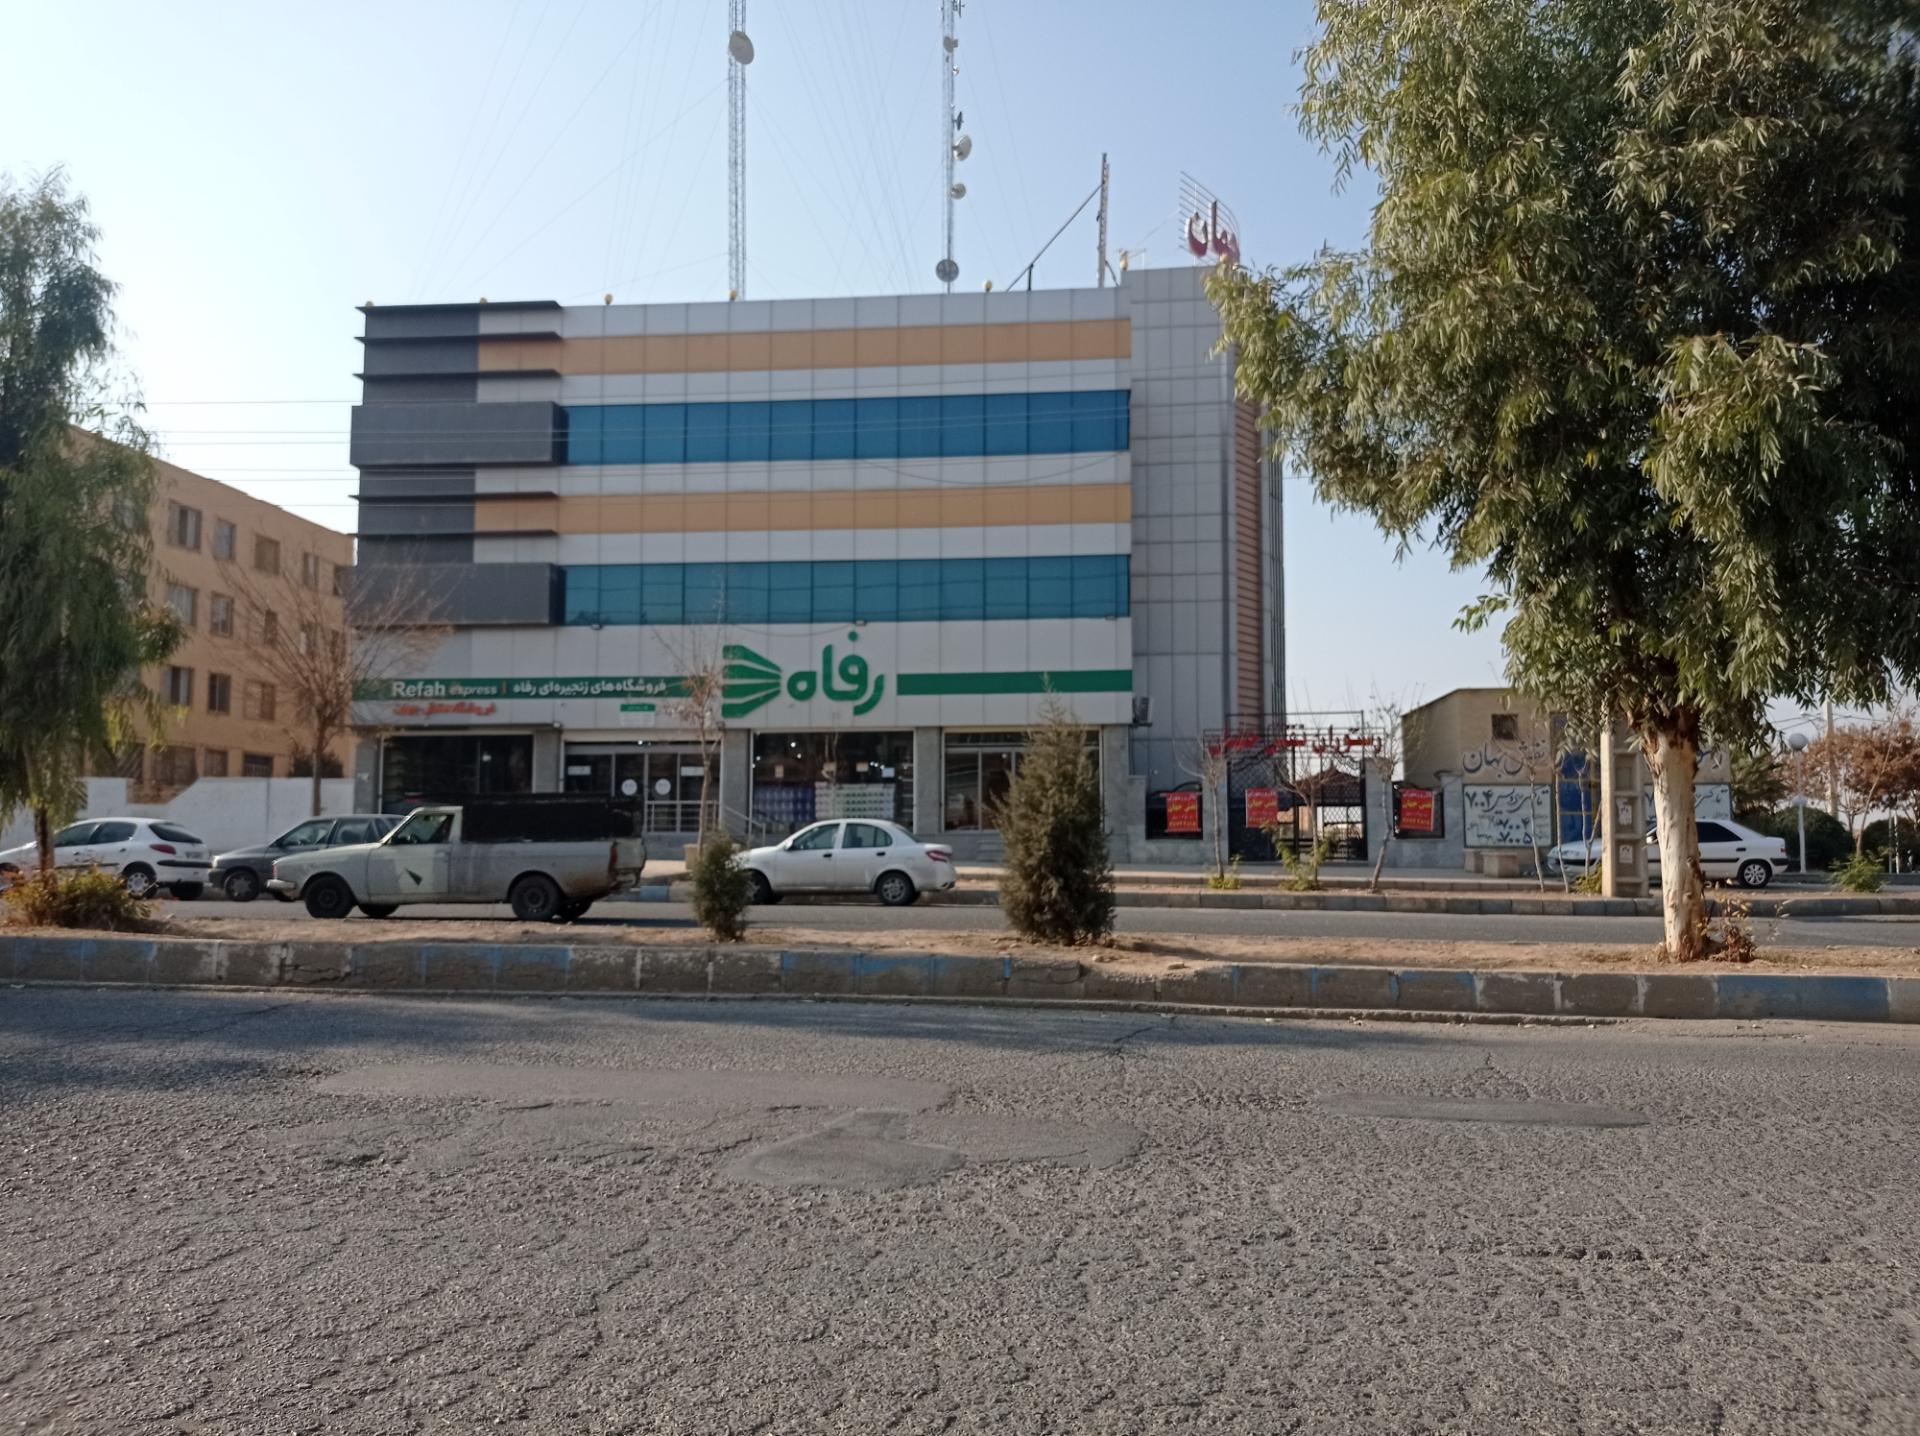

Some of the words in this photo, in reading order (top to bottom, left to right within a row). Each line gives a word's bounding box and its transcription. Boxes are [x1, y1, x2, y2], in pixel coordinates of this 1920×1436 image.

[787, 631, 885, 716] رفاه
[393, 681, 446, 697] Refah
[513, 681, 536, 696] رفاه
